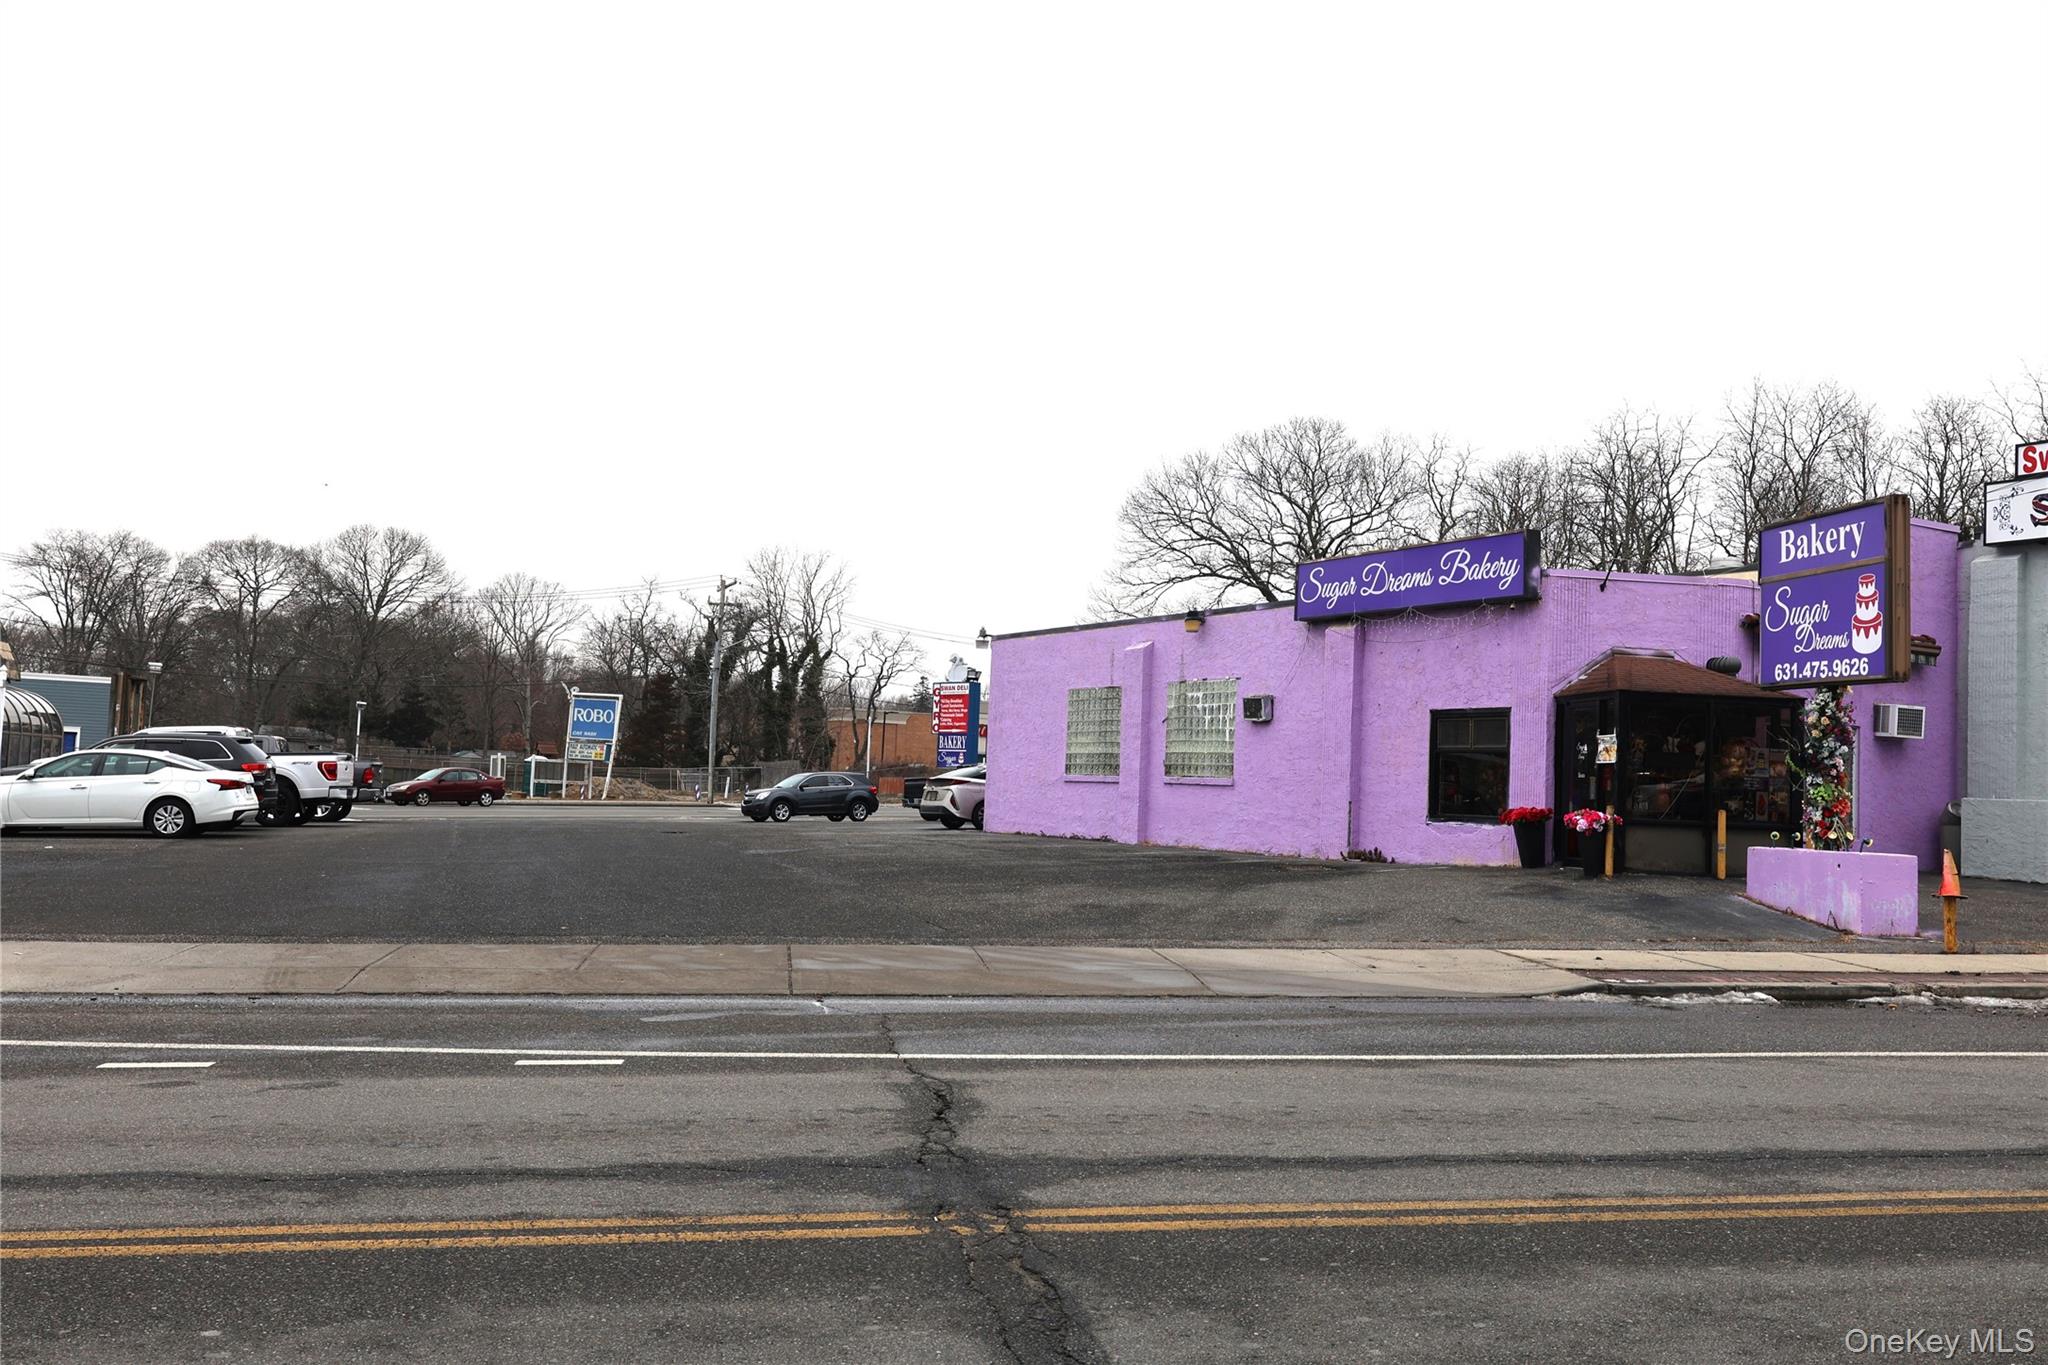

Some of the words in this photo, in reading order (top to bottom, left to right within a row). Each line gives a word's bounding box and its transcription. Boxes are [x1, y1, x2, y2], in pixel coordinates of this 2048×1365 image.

[1779, 520, 1866, 564] Bakery
[1300, 567, 1357, 609] Sugar
[1360, 560, 1434, 596] Dreams
[1438, 547, 1520, 590] Bakery
[1765, 586, 1830, 635] Sugar
[1793, 622, 1850, 653] Dreams
[1774, 657, 1869, 682] 631.475.9626
[574, 708, 614, 723] ROBO
[939, 736, 967, 749] BAKERY
